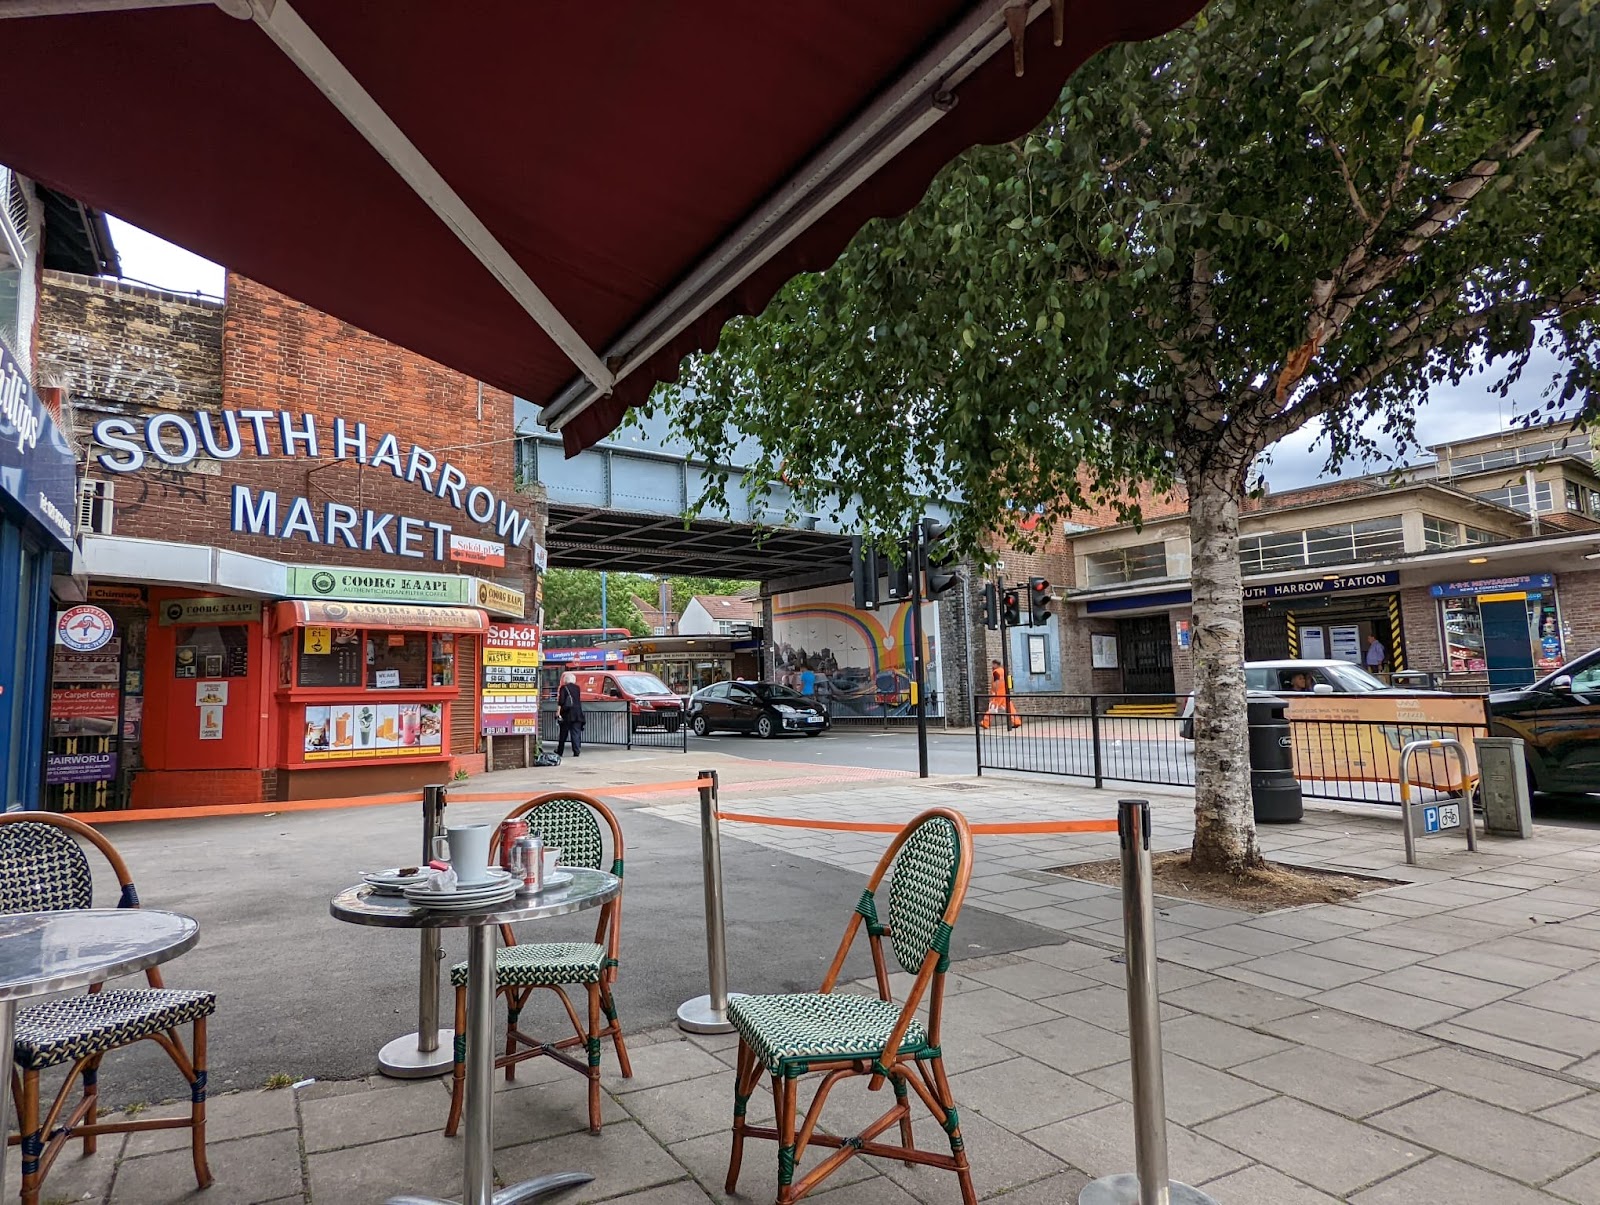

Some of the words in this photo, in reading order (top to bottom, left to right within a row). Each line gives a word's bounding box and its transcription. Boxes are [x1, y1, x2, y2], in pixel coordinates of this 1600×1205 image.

[93, 409, 319, 472] SOUTH
[334, 416, 531, 547] HARROW
[231, 485, 452, 561] MARKET
[342, 575, 395, 589] COORG
[401, 578, 448, 592] KAAPI
[1274, 581, 1324, 595] HARROW
[1333, 574, 1386, 589] STATION
[1471, 576, 1531, 587] NEWSAGENTS
[343, 587, 380, 595] AUTHENTIC
[381, 588, 405, 596] INDIAN
[187, 605, 219, 614] COORG
[222, 603, 253, 612] KAAPI
[353, 604, 410, 615] COORG
[416, 608, 467, 617] KAAPI
[61, 612, 75, 626] KEY
[76, 607, 111, 626] CUTTING
[487, 638, 514, 647] POLISH
[64, 691, 89, 699] Carpet
[48, 754, 110, 765] HAIRWORLD
[1426, 808, 1436, 831] P
